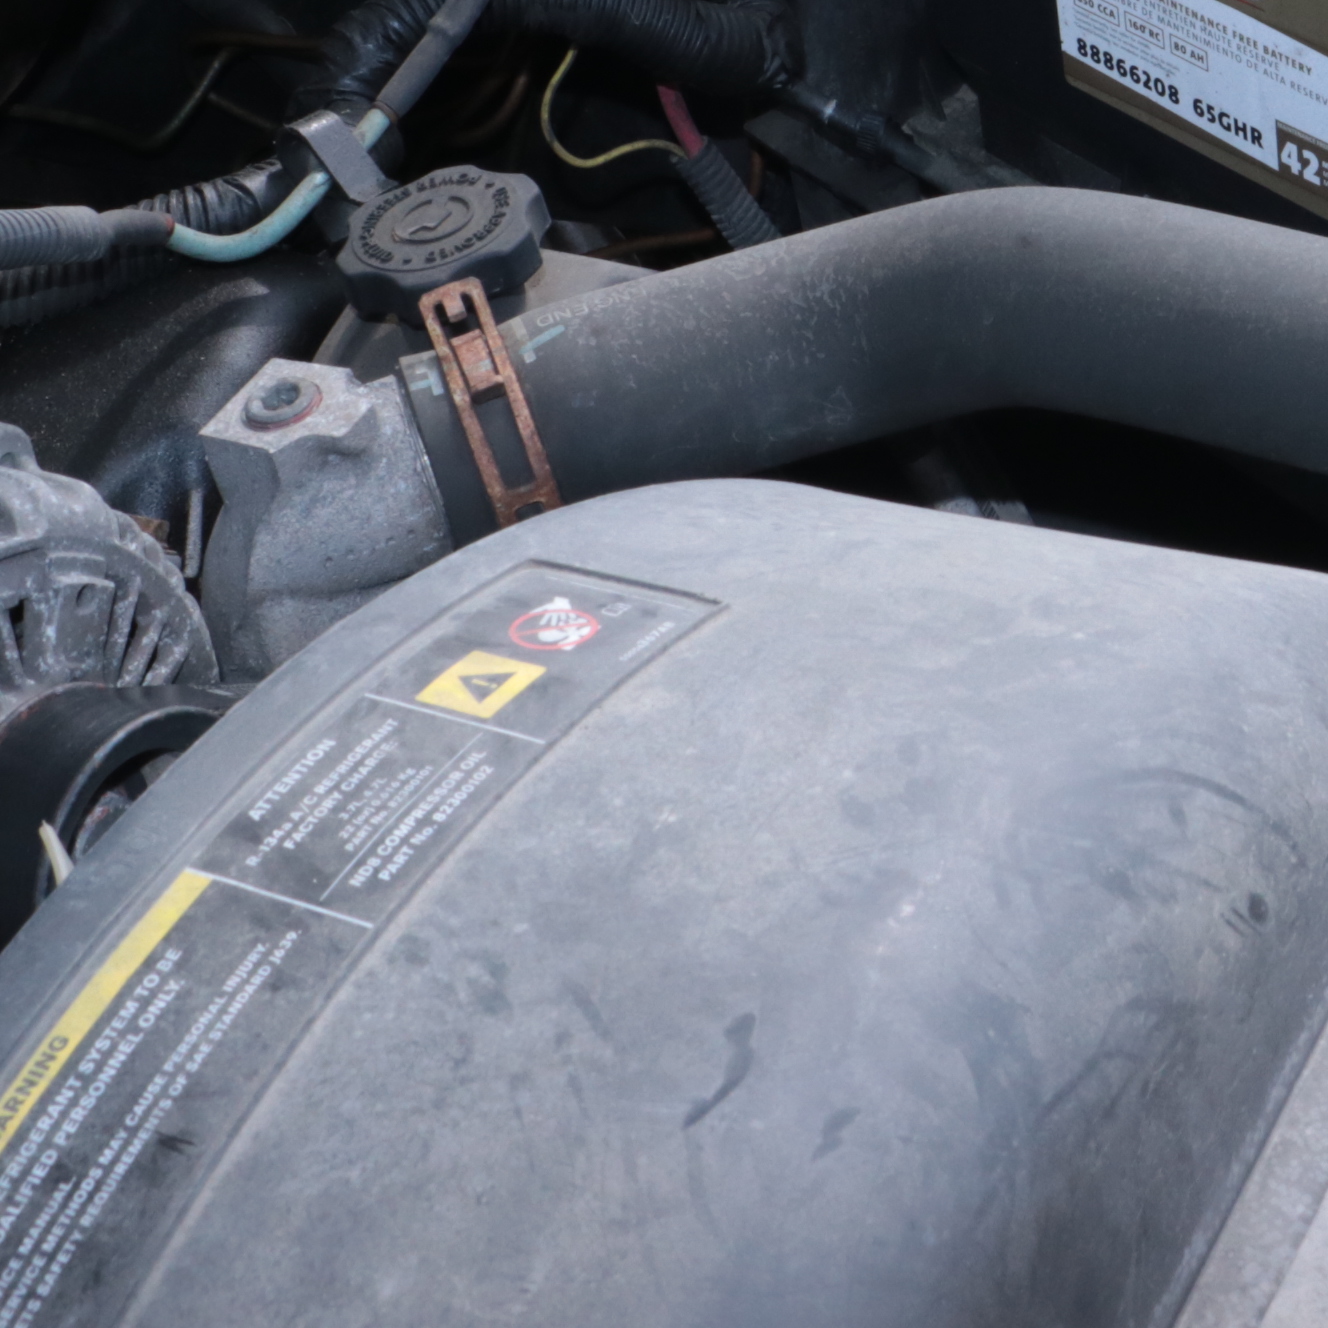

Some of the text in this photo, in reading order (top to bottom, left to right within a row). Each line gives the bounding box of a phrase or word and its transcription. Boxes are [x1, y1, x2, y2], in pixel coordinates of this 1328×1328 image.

[1097, 2, 1115, 20] CCA
[1128, 18, 1160, 42] 160 RC
[1141, 6, 1152, 19] DE
[1157, 13, 1242, 64] MANTENIMIENTO
[1246, 58, 1259, 73] DE
[1262, 66, 1286, 86] ALTA
[1200, 24, 1231, 48] HAUTE
[1173, 40, 1204, 64] 80 AH
[1232, 29, 1258, 51] FREE
[1262, 44, 1312, 77] BATTERY
[1075, 36, 1180, 106] 88866208
[1192, 95, 1263, 149] 65GHR
[1279, 135, 1321, 187] 42
[536, 302, 589, 327] END
[245, 717, 400, 867] R-134a A/C REFRIGERANT
[248, 738, 337, 822] ATTENTION
[377, 771, 464, 857] COMPRESSOR
[460, 750, 487, 771] OIL
[283, 790, 344, 851] FACTORY
[344, 824, 373, 852] PART
[377, 764, 495, 882] PART No. 82300102
[0, 947, 183, 1202] FRIGERANT SYSTEM TO BE
[41, 1166, 102, 1253] METHODS
[98, 1128, 128, 1166] MAY
[125, 1072, 168, 1126] CAUSE
[163, 994, 228, 1074] PERSONAL
[223, 942, 270, 993] INJURY.
[53, 1030, 145, 1148] PERSONNEL
[138, 978, 186, 1029] ONLY.
[36, 1228, 83, 1298] SAFETY
[79, 1096, 173, 1228] REQUIREMENTS
[168, 1073, 188, 1097] OF
[185, 1044, 213, 1074] SAE
[208, 964, 272, 1041] STANDARD
